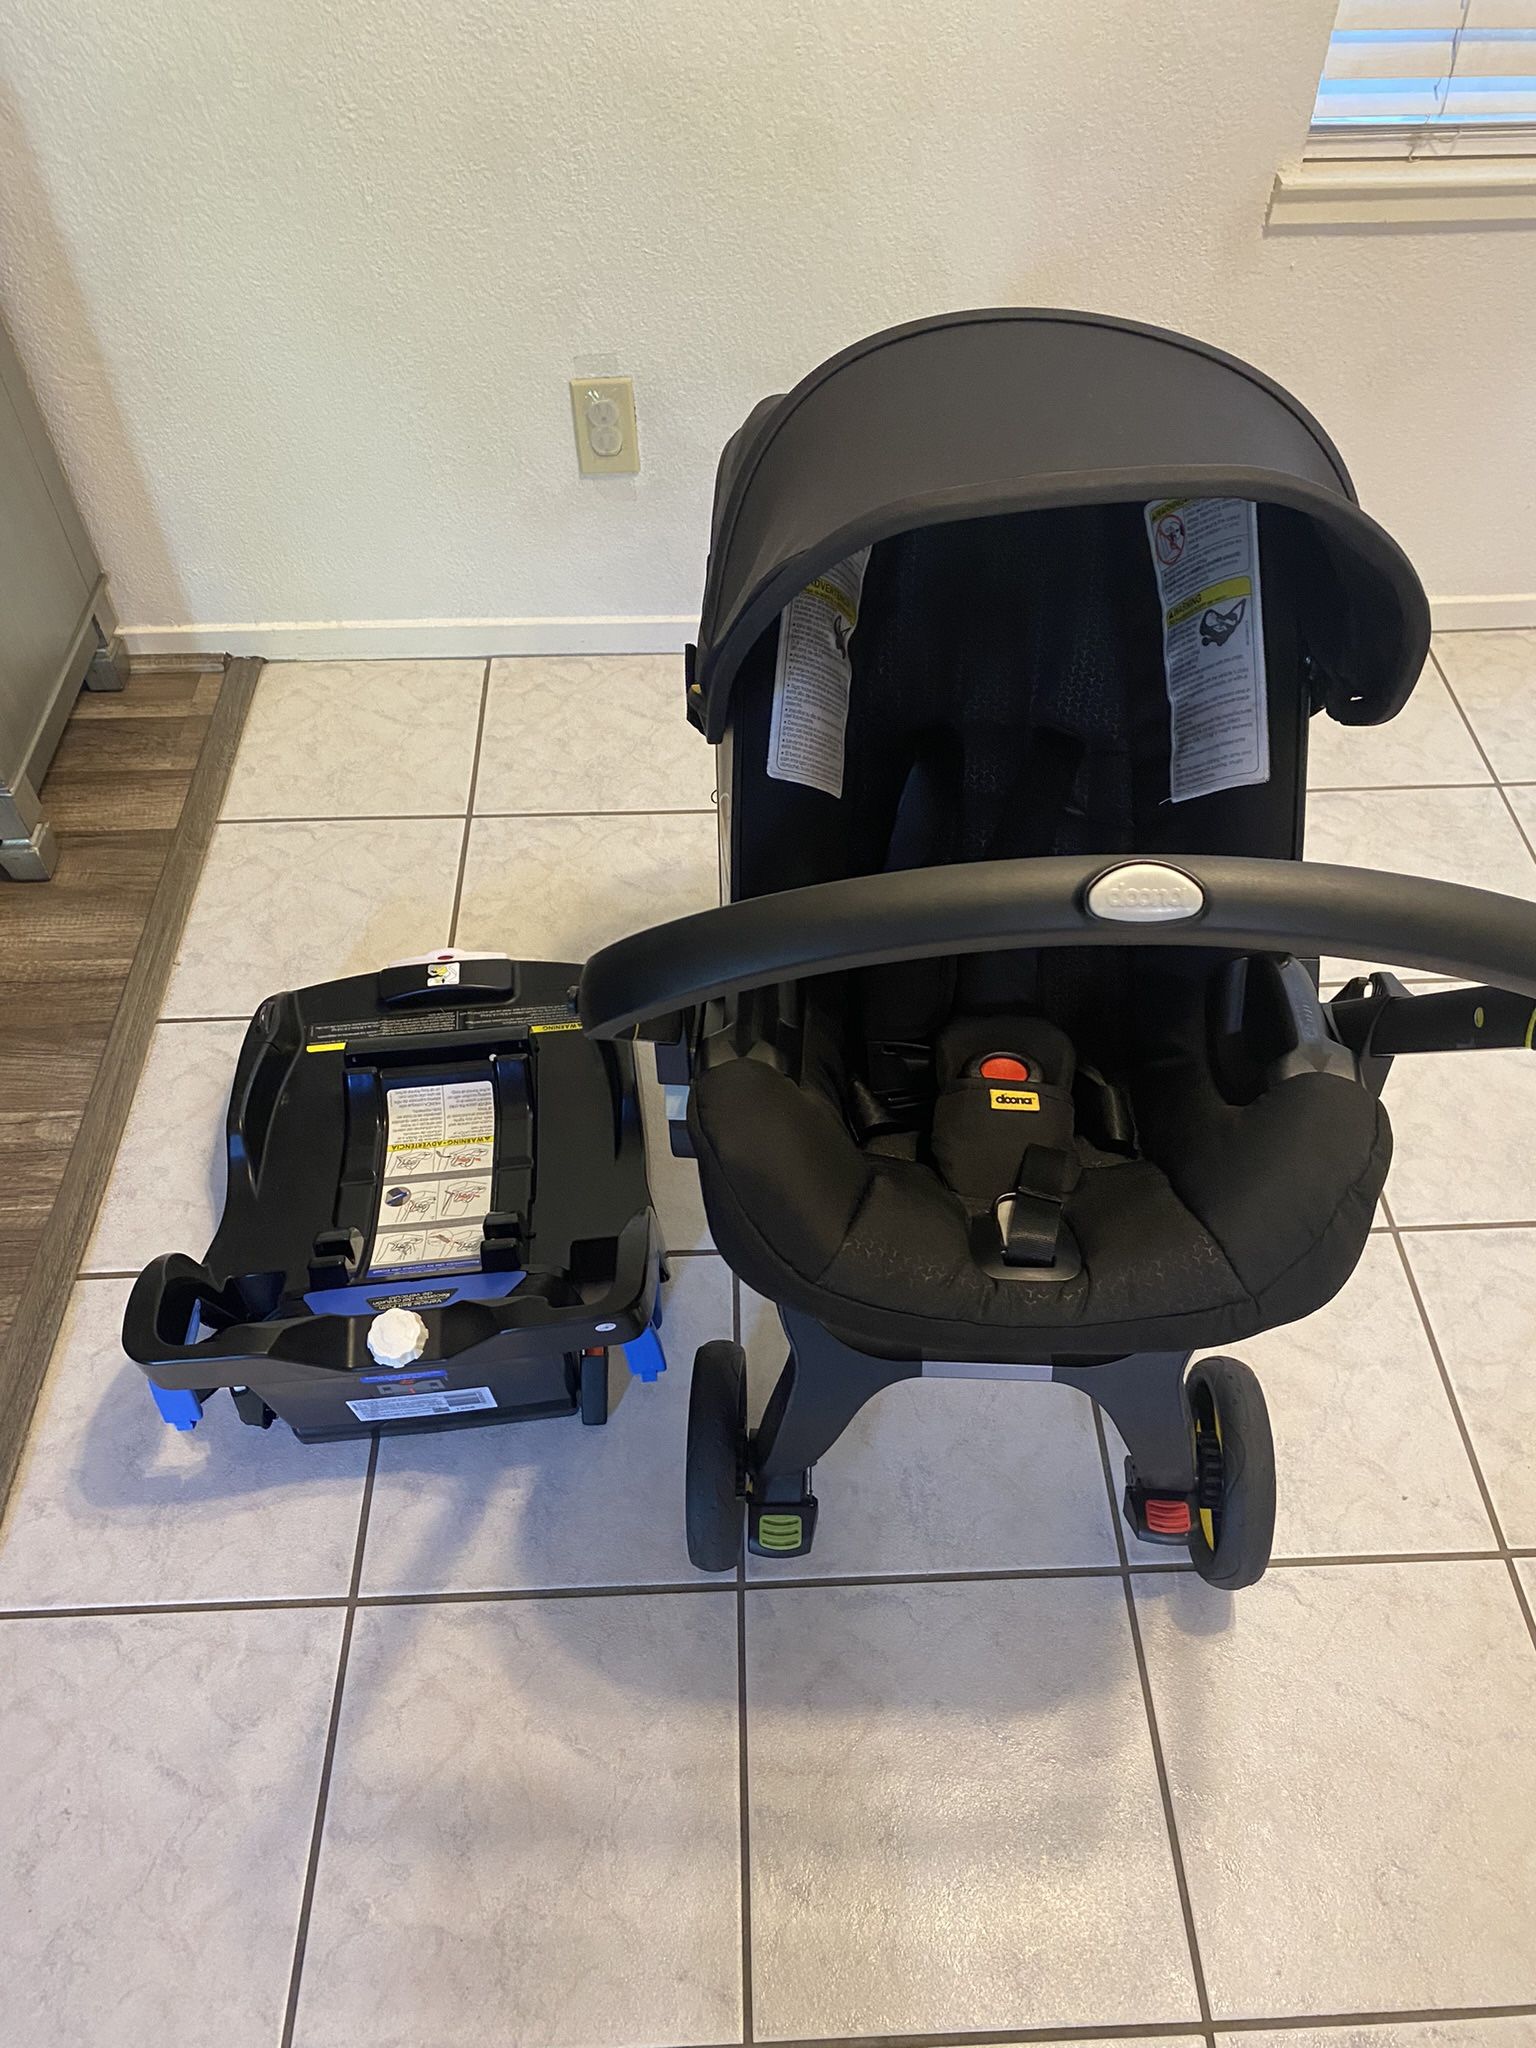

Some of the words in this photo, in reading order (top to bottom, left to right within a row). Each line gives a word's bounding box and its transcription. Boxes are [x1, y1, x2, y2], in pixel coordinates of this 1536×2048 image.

[1106, 882, 1181, 907] doona
[542, 1023, 578, 1032] WARNING
[995, 1094, 1033, 1105] doona
[391, 1141, 443, 1150] ADVERTENCIA
[447, 1137, 485, 1146] WARNING
